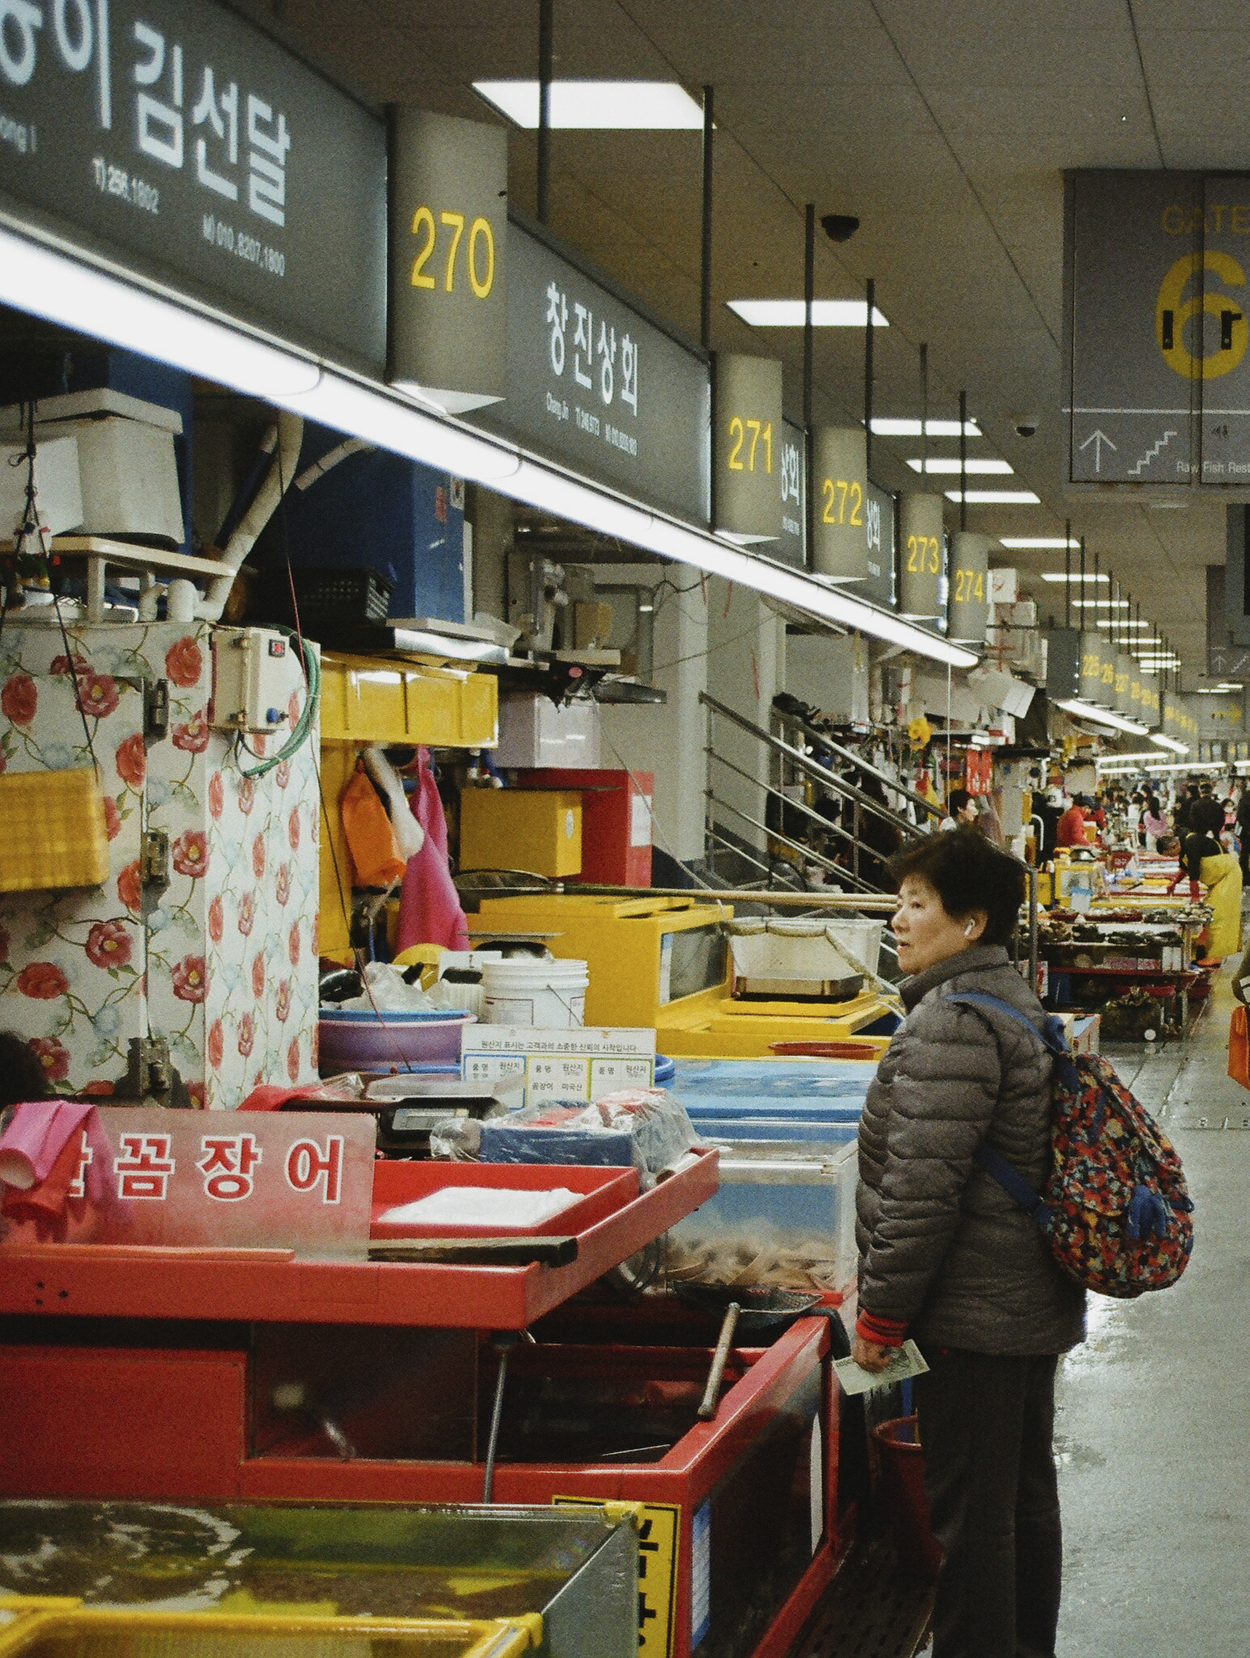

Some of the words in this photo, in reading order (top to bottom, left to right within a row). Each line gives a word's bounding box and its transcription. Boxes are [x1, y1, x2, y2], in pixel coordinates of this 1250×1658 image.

[134, 21, 291, 227] 김선달
[411, 206, 494, 299] 270
[1155, 250, 1249, 380] 6
[547, 282, 638, 417] 창진상회
[729, 417, 773, 474] 271
[1177, 460, 1199, 474] Raw
[1203, 460, 1223, 475] Fish
[823, 479, 863, 527] 272
[907, 535, 939, 574] 273
[955, 570, 983, 604] 274
